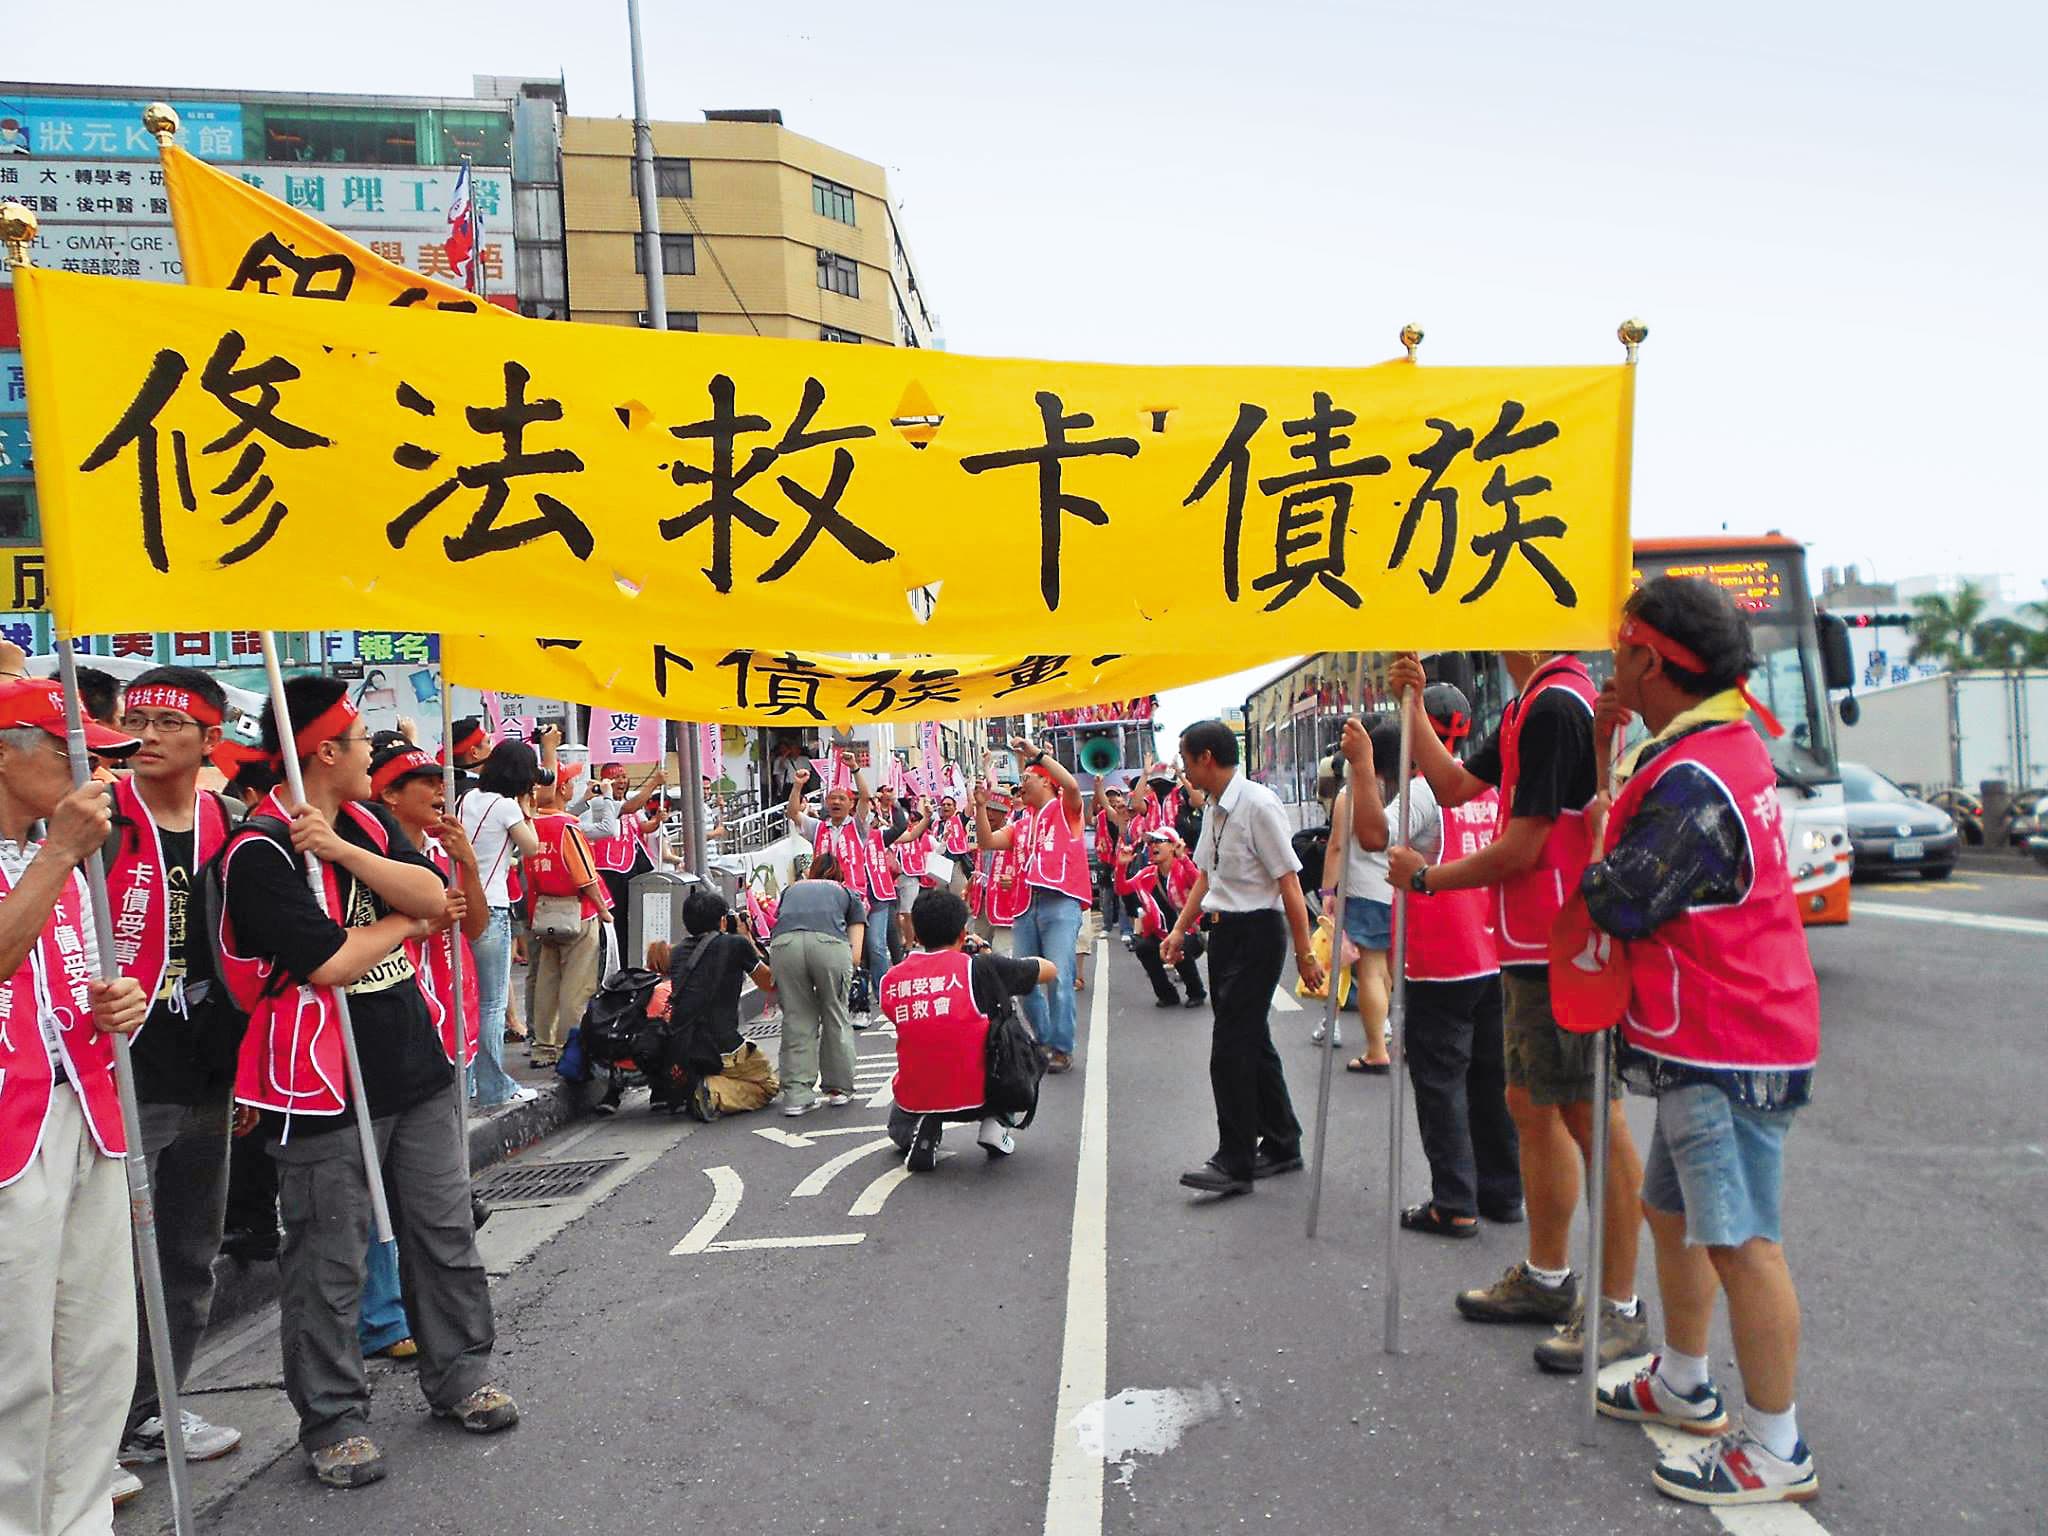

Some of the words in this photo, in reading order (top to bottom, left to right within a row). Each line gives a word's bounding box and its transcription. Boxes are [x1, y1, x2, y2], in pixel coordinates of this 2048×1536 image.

[67, 235, 115, 251] GMAT
[130, 236, 163, 251] GRE
[80, 329, 1578, 611] 修法救卡債族
[359, 634, 429, 661] 報名
[886, 973, 964, 1000] 卡債受害人
[895, 996, 951, 1023] 自救會
